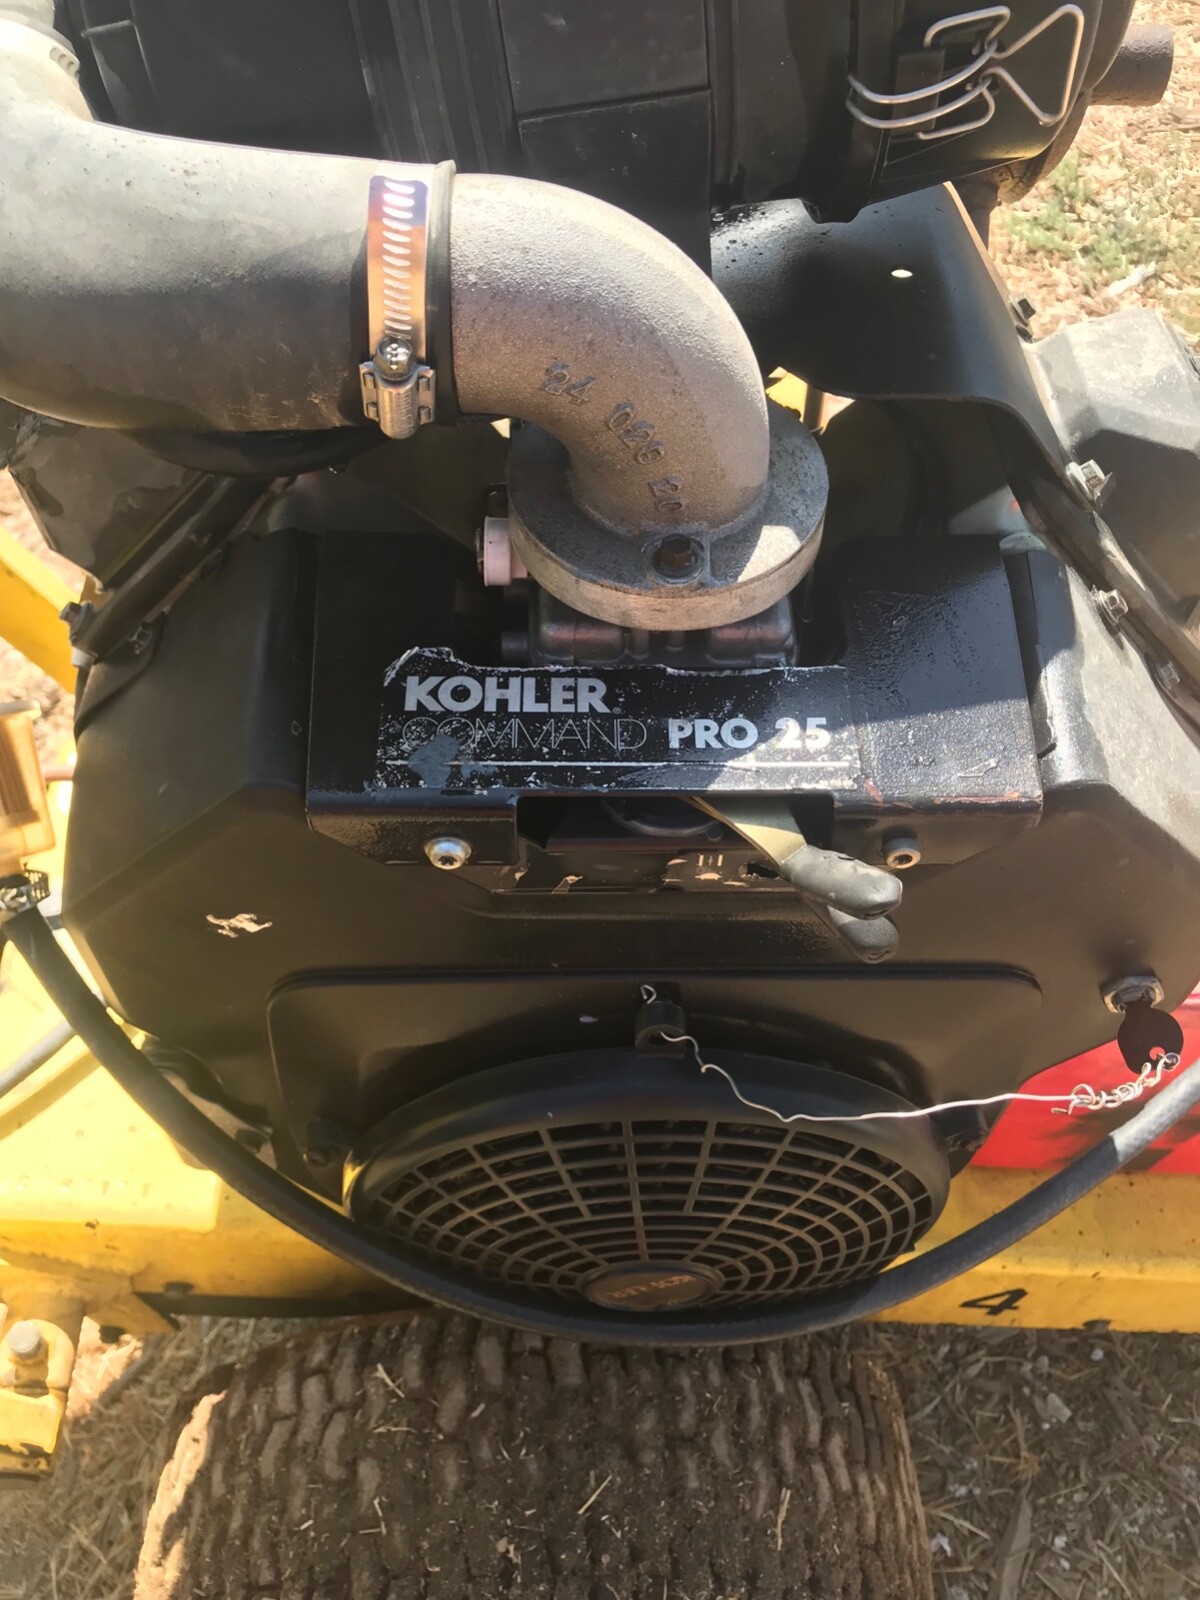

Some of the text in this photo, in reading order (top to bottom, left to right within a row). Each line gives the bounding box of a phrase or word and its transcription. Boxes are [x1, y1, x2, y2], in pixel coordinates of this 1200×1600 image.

[541, 361, 596, 405] 24
[403, 675, 612, 713] KOHLER
[402, 716, 832, 751] COMMAND PRO 25
[959, 1288, 1028, 1316] 4
